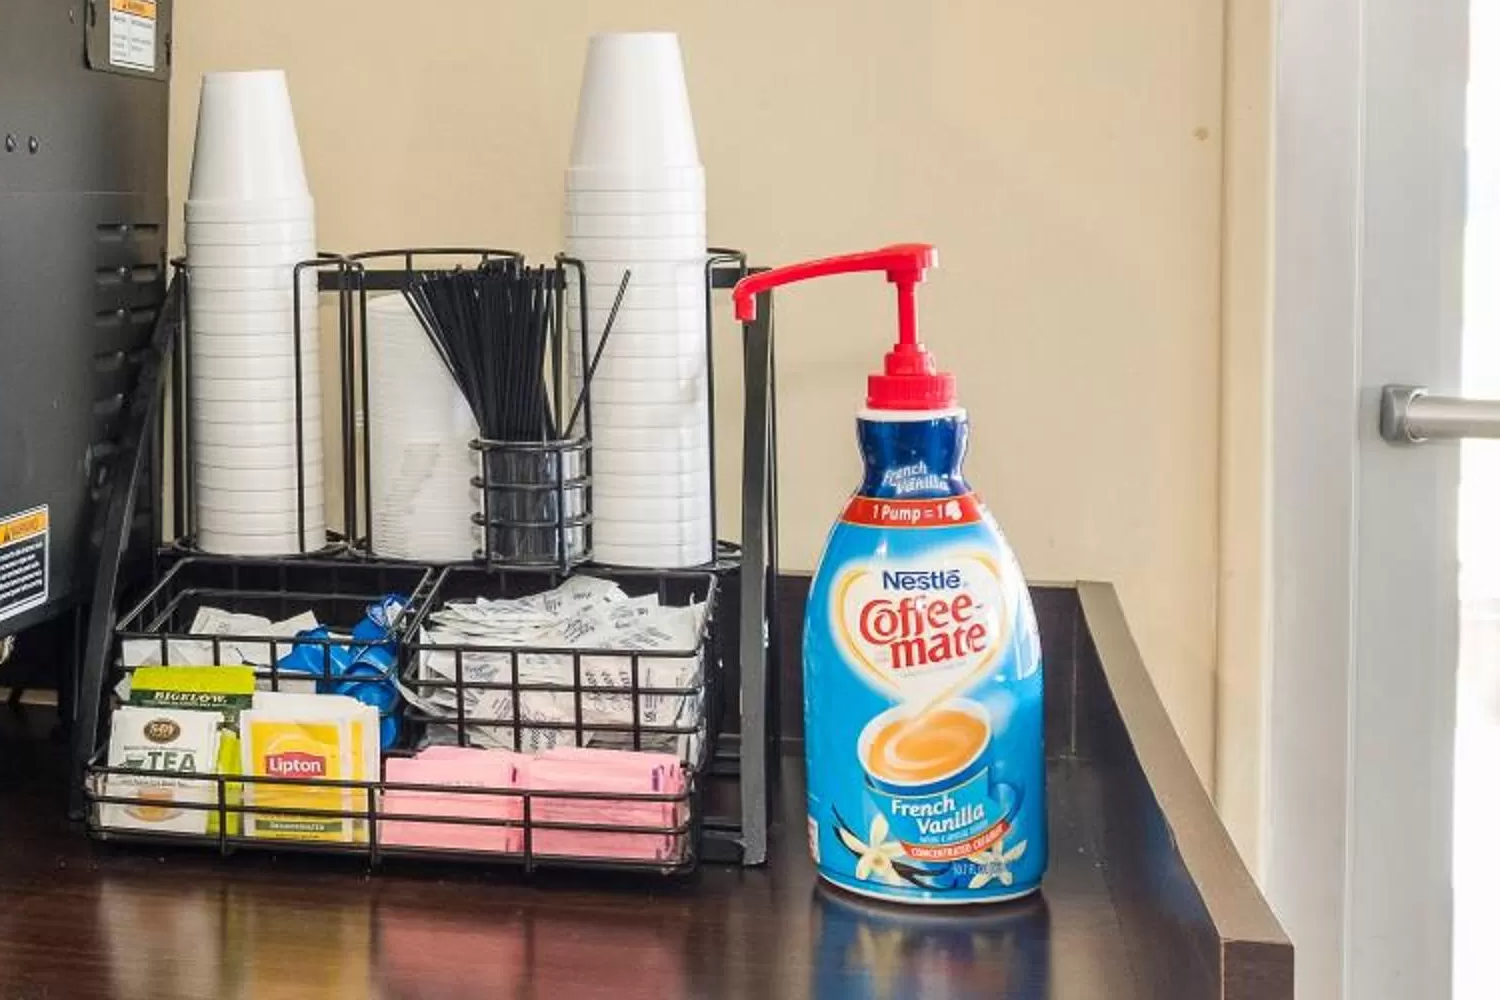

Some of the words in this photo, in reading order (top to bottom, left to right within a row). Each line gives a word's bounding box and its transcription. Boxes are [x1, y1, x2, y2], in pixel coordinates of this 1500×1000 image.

[881, 460, 927, 487] French
[872, 503, 879, 519] 1
[881, 503, 920, 525] Pump
[883, 570, 961, 590] Nestlé
[859, 594, 973, 645] Coffee
[890, 622, 987, 669] mate
[148, 752, 197, 773] TEA
[269, 757, 321, 776] Lipton
[891, 795, 955, 817] French
[916, 804, 985, 834] Vanilla
